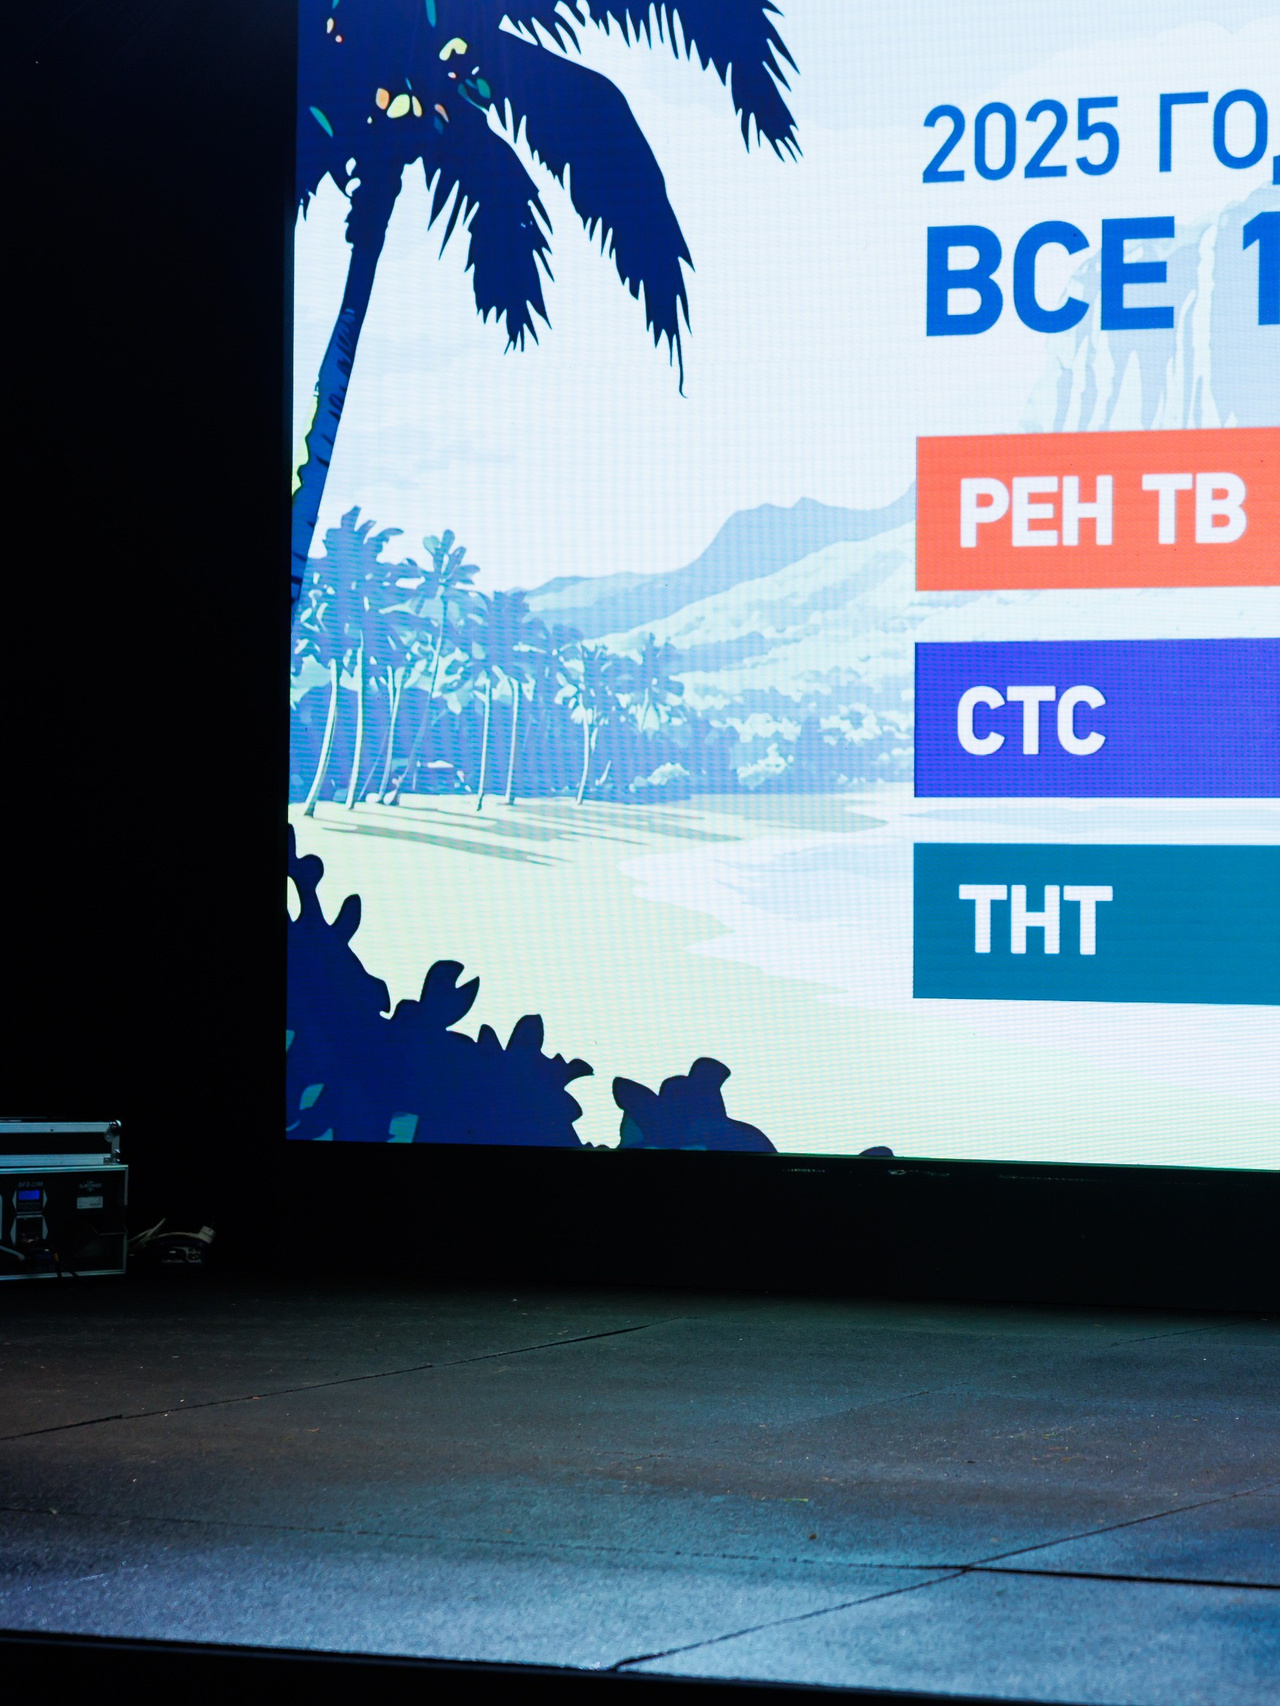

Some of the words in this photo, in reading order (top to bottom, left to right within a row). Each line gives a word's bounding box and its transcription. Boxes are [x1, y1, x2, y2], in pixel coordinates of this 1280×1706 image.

[922, 96, 1120, 184] 2025
[926, 216, 1175, 337] ВСЕ
[959, 475, 1114, 549] РЕН
[1142, 471, 1248, 545] ТВ
[956, 684, 1107, 756] СТС
[958, 884, 1113, 957] ТНТ
